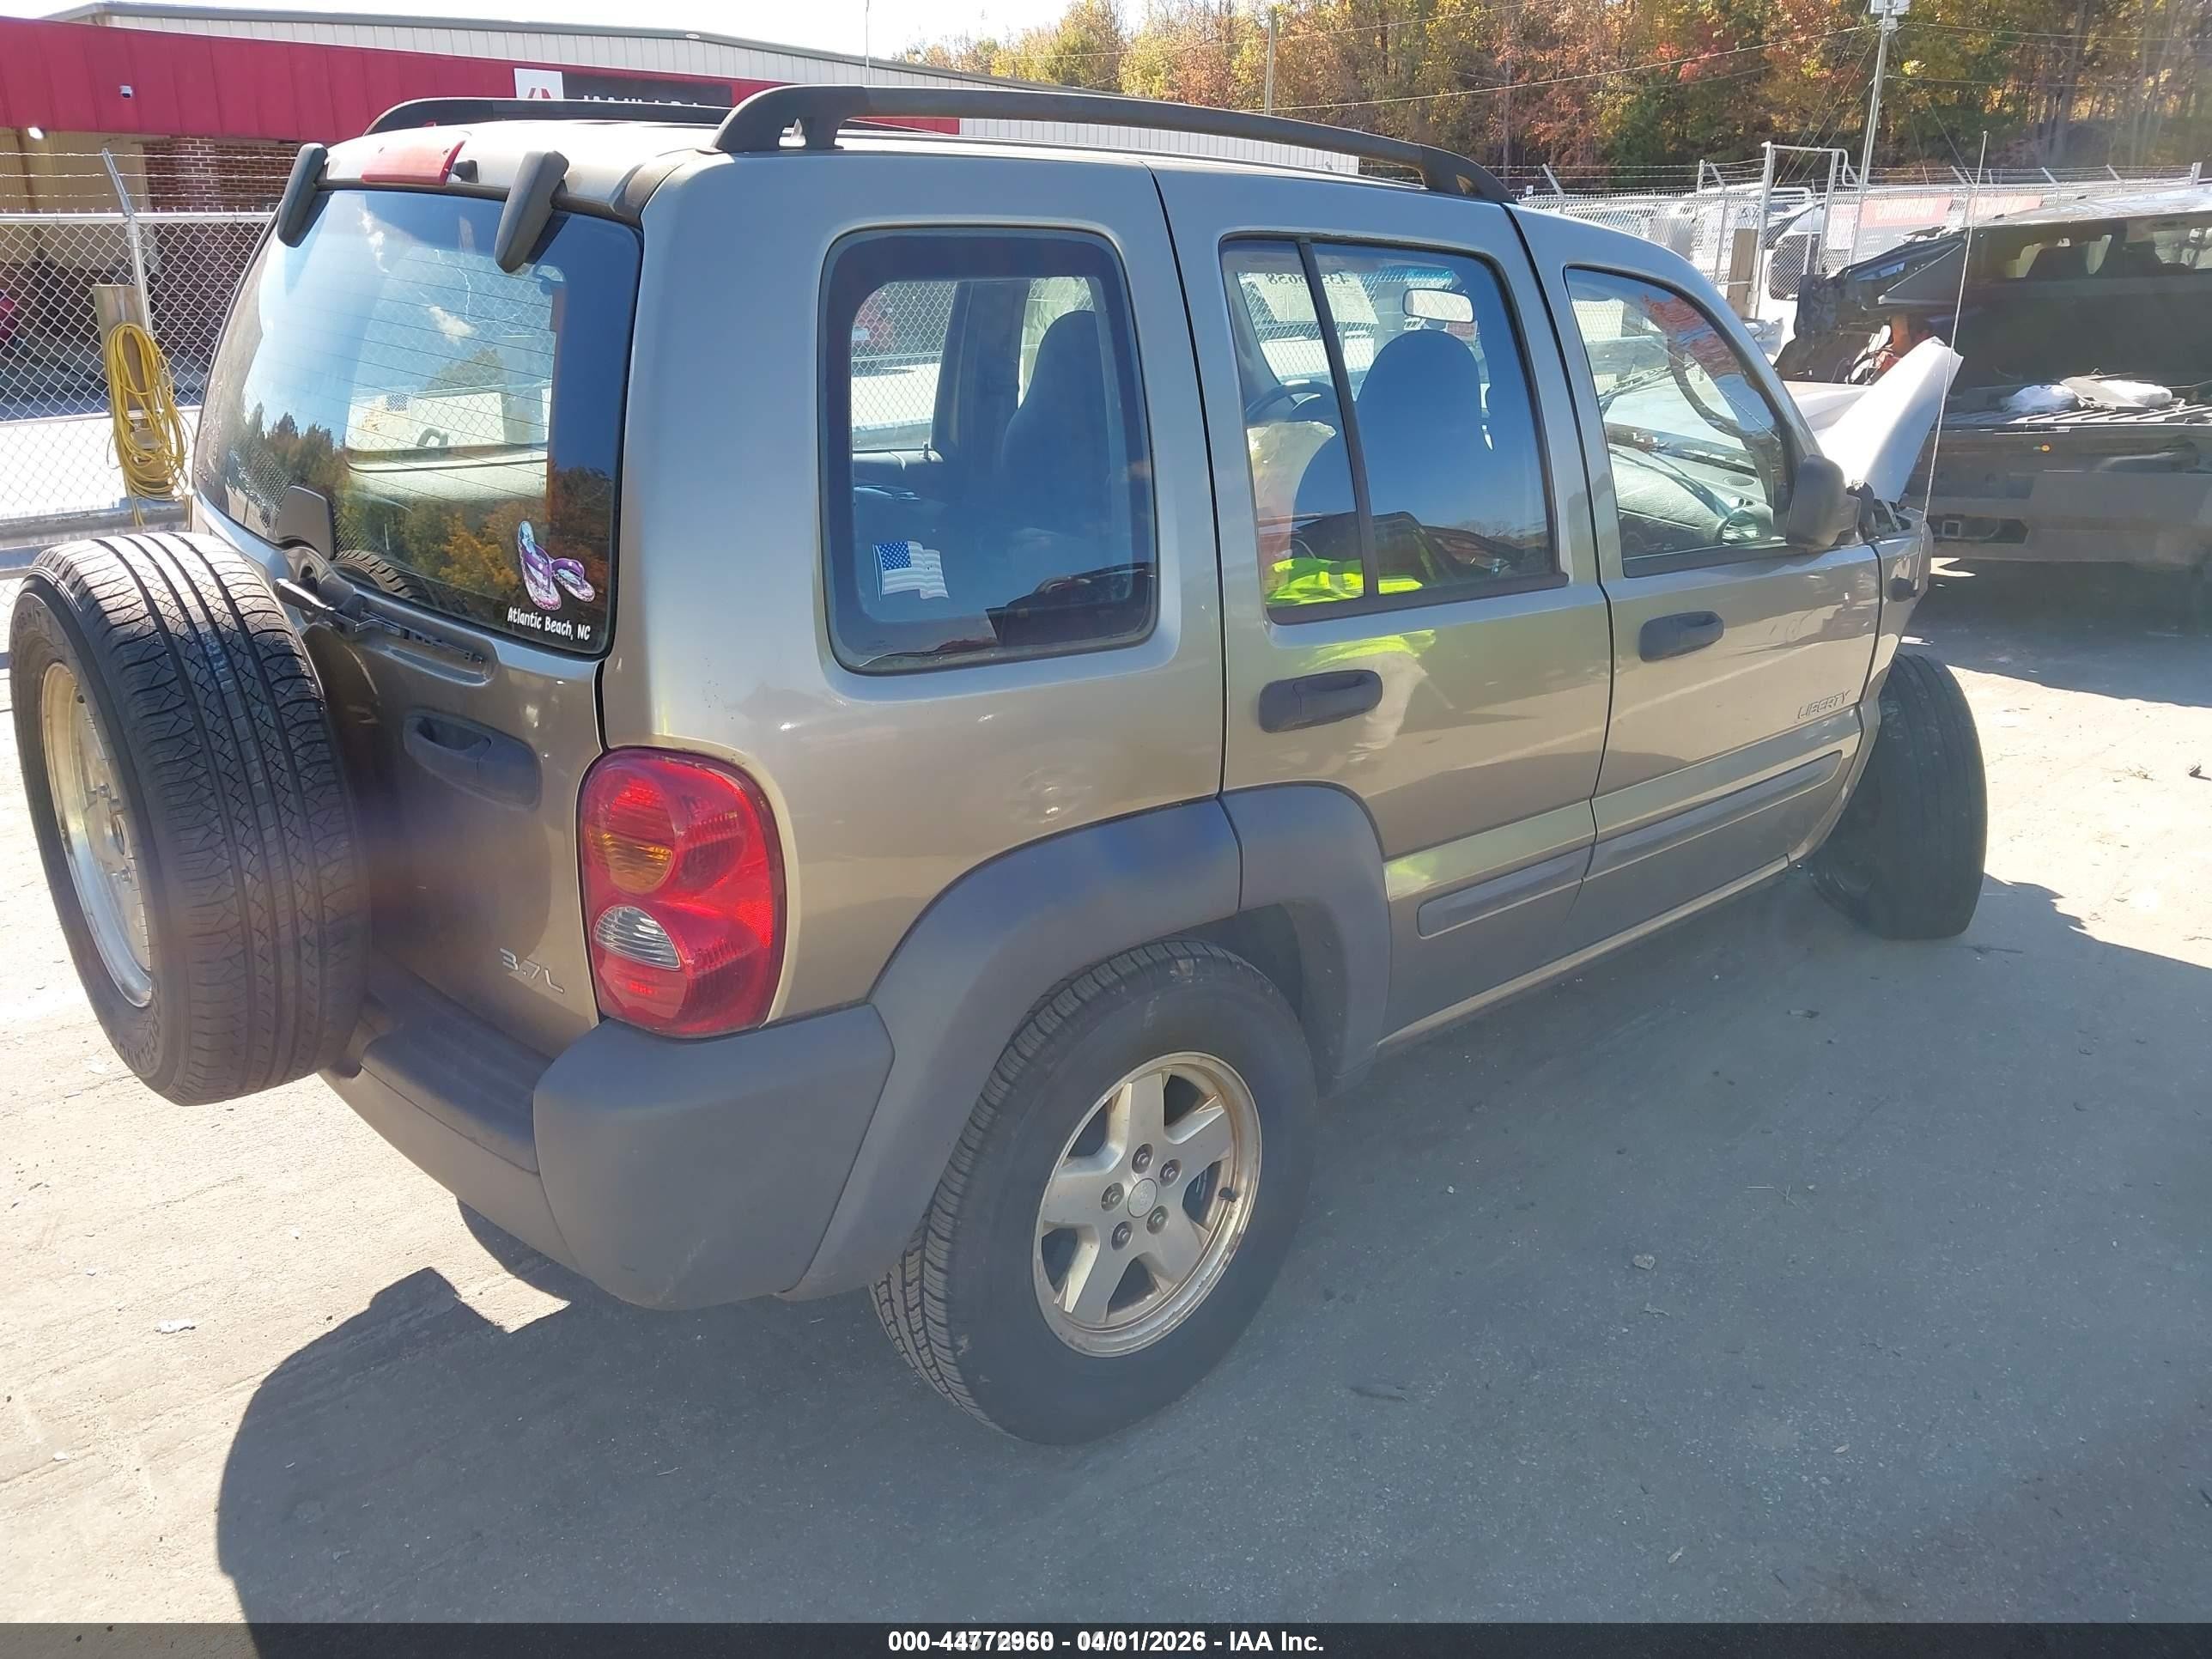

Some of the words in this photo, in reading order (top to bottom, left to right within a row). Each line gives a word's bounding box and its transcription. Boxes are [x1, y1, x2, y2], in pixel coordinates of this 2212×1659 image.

[507, 606, 542, 629] Atlantic
[544, 616, 574, 641] Beach,
[577, 623, 591, 641] NC
[1797, 690, 1851, 719] LIBERTY
[500, 947, 564, 993] 3.7L
